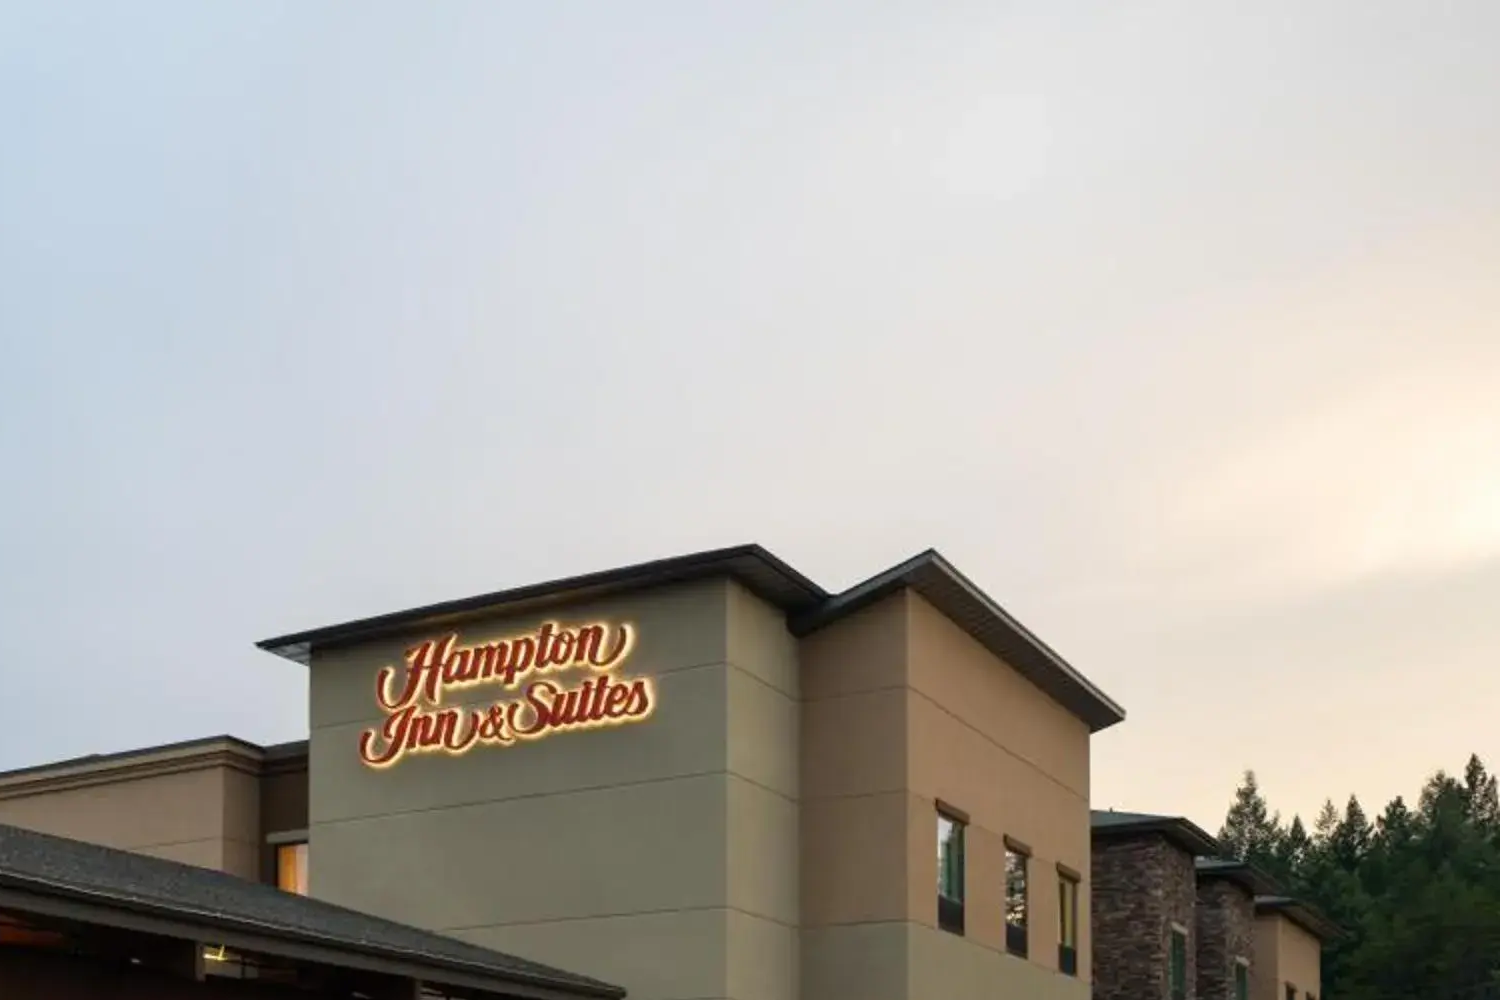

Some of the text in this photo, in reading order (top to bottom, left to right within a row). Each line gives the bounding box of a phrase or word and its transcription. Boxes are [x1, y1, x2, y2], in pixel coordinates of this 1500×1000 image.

[376, 621, 631, 709] Hampton
[358, 675, 651, 764] Inn & Suites
